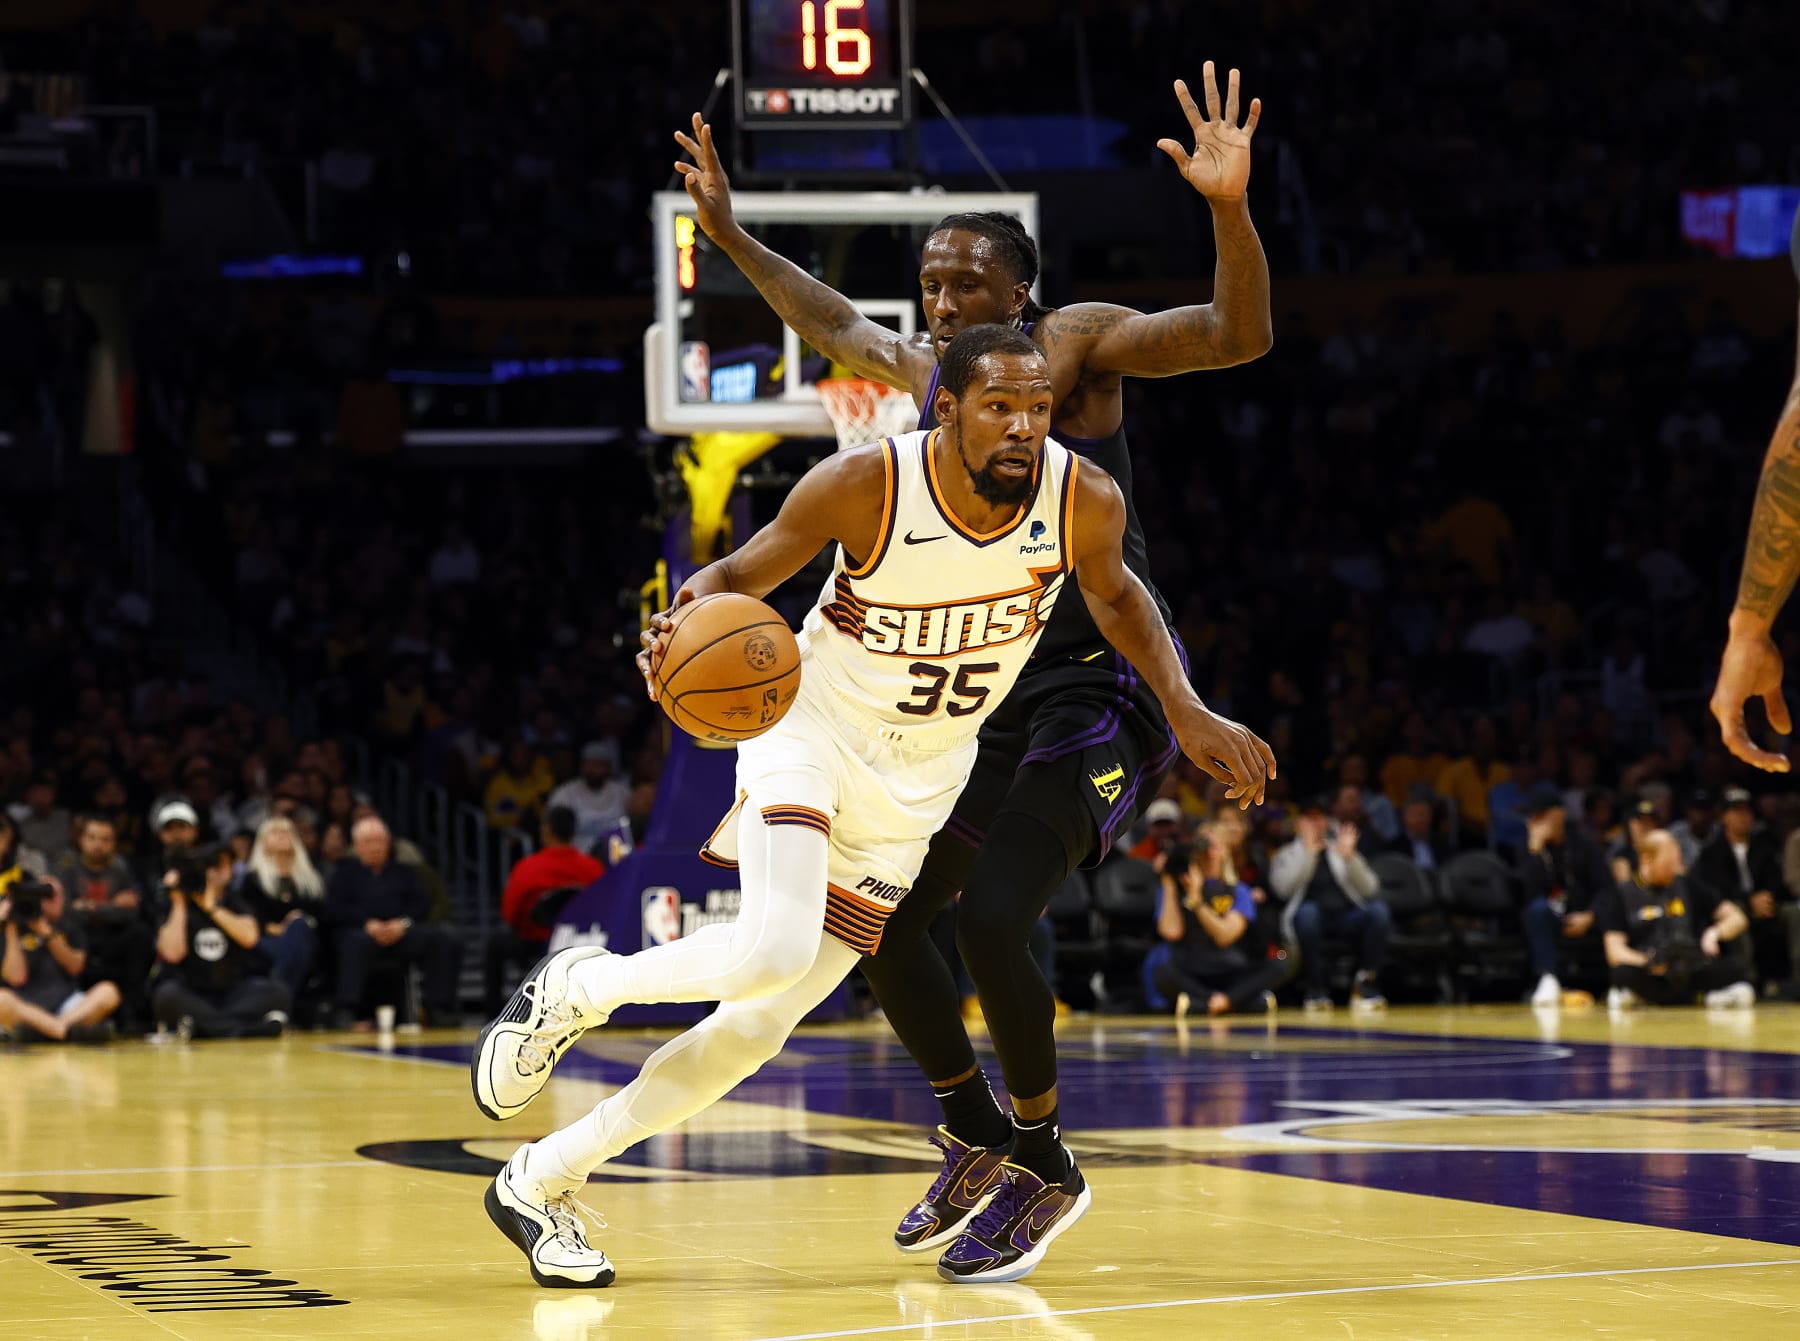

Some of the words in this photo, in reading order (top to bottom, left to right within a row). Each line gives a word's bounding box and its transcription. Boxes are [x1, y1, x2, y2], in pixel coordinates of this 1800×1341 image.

[801, 0, 871, 75] 16
[790, 88, 899, 113] TISSOT
[1019, 541, 1057, 556] PayPal
[861, 594, 1032, 656] SUNS
[896, 662, 1000, 717] 35
